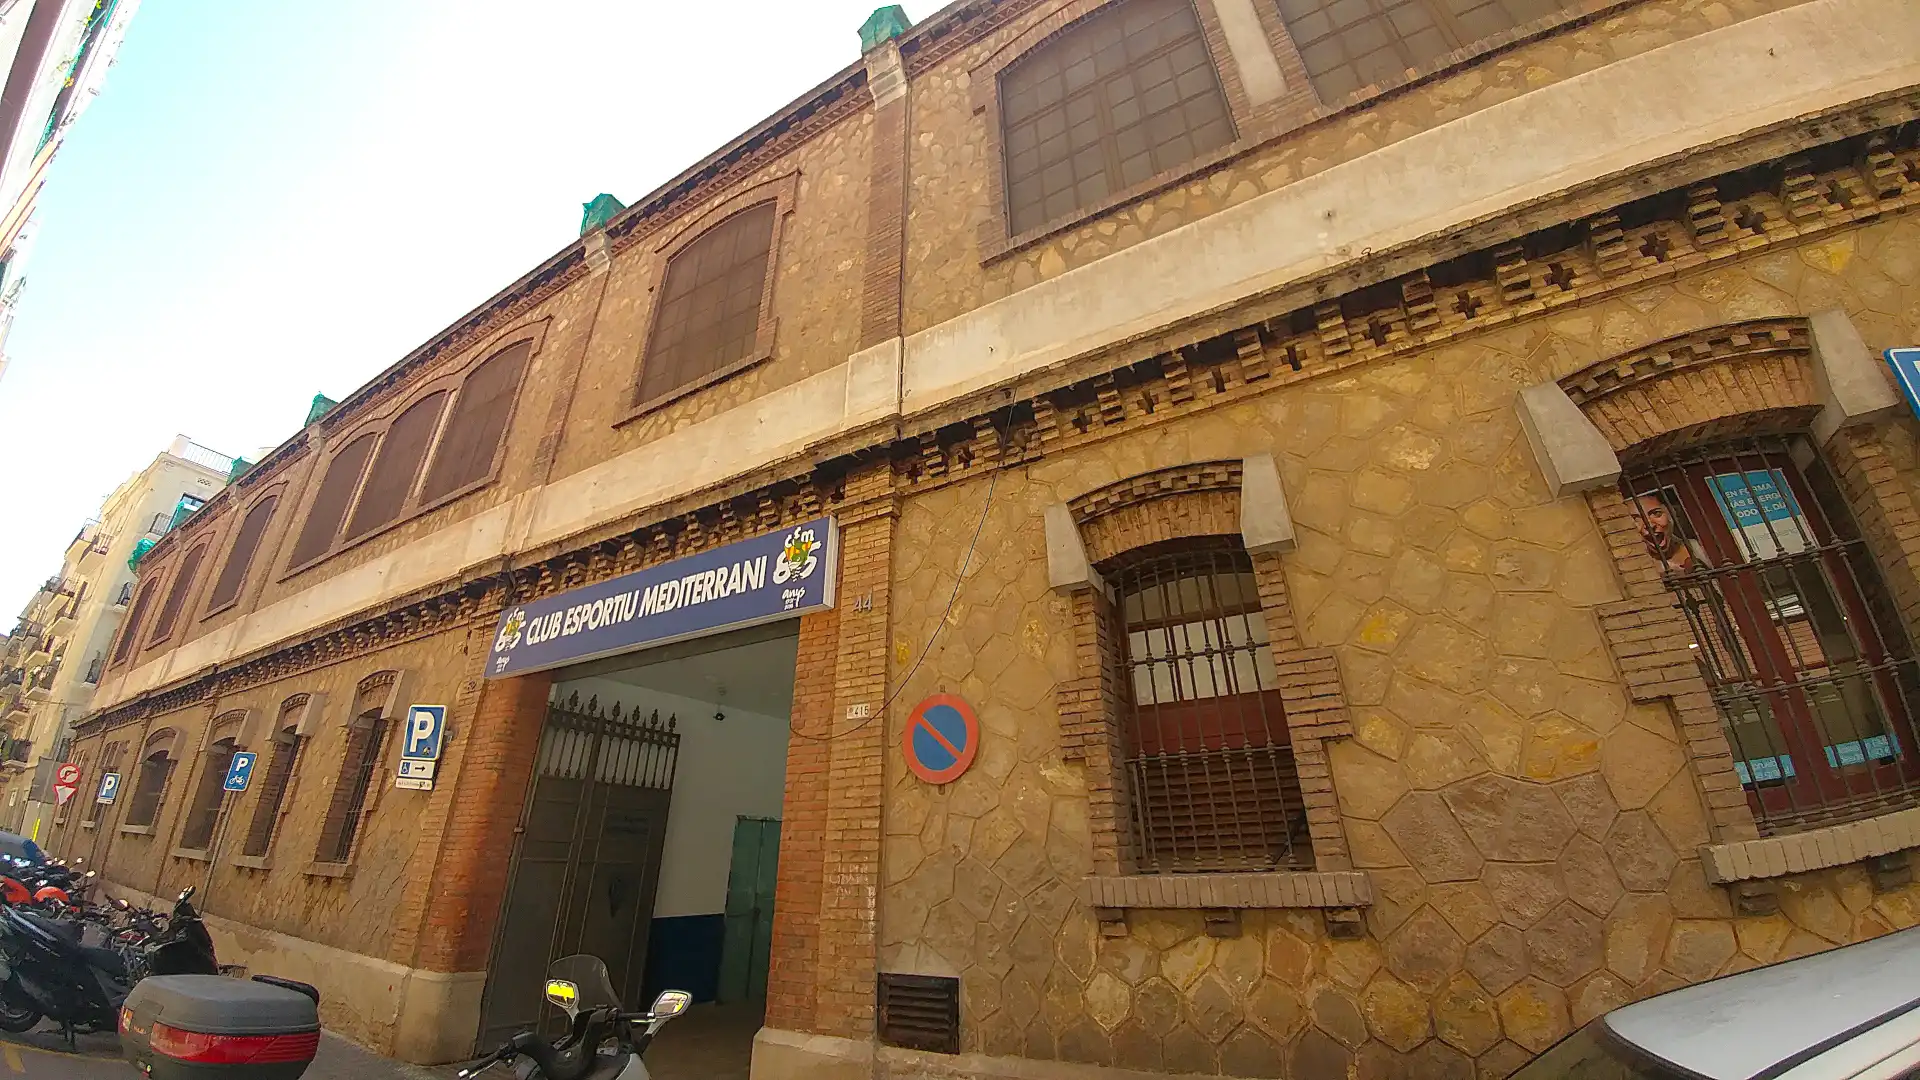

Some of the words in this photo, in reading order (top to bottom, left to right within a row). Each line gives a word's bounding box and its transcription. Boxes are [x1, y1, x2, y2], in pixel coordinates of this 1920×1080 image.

[526, 611, 562, 646] CLUB
[562, 589, 641, 636] ESPORTIU
[638, 555, 767, 617] MEDITERRANI
[853, 592, 873, 612] 44
[408, 711, 436, 753] P
[235, 757, 249, 772] P
[102, 776, 116, 796] P
